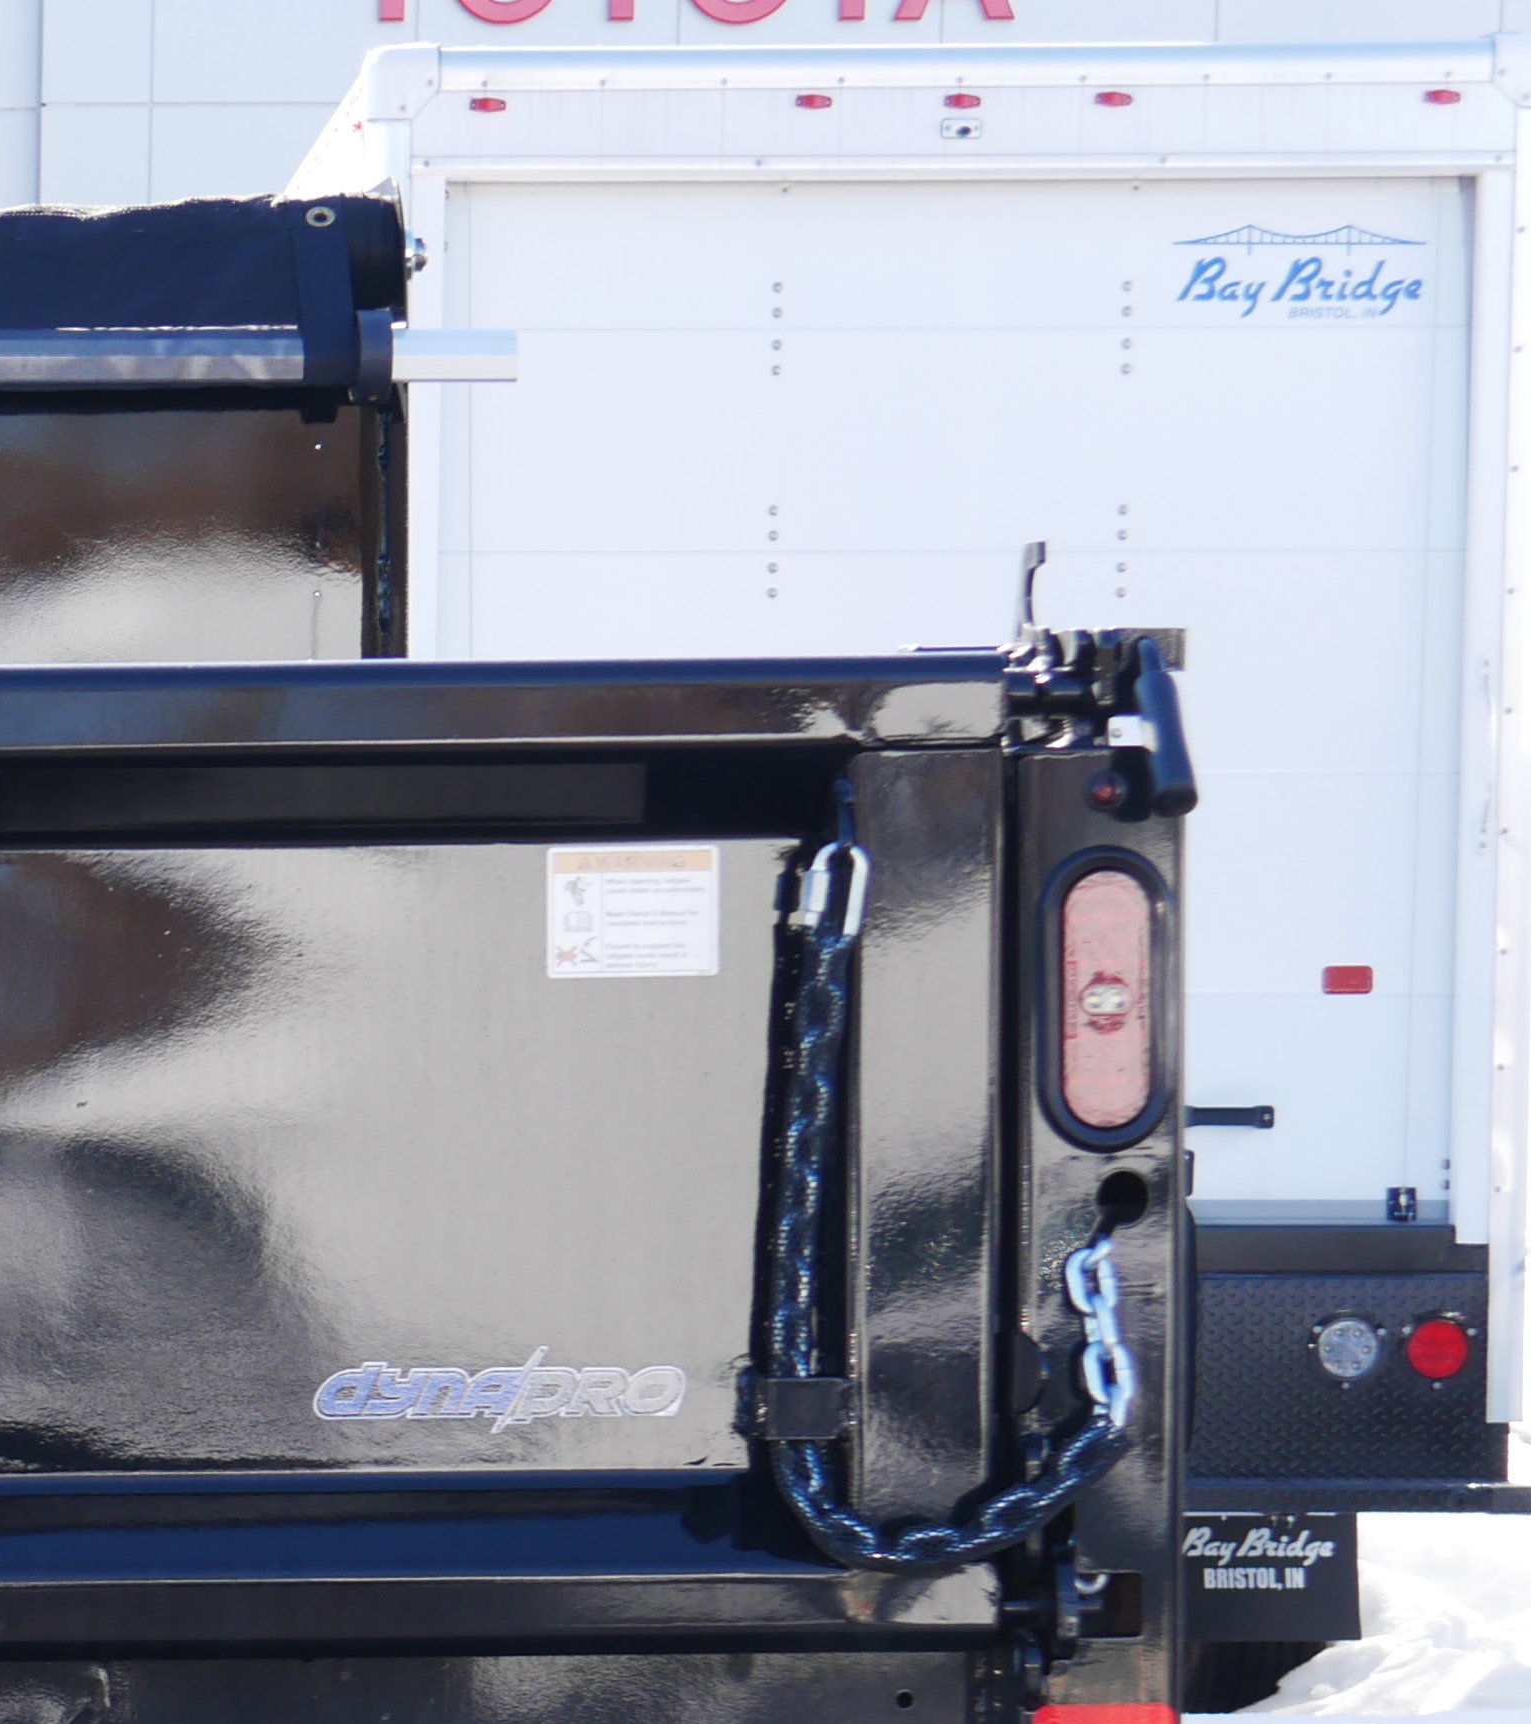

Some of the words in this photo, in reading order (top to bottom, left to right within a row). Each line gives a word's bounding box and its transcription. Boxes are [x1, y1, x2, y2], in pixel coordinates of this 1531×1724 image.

[1176, 256, 1267, 318] Bay
[1270, 256, 1423, 316] Bridge
[1361, 306, 1377, 318] IN
[1182, 1526, 1238, 1567] Bay
[1236, 1527, 1335, 1566] Bridge
[1203, 1567, 1283, 1590] BRISTOL,
[1285, 1567, 1305, 1589] IN
